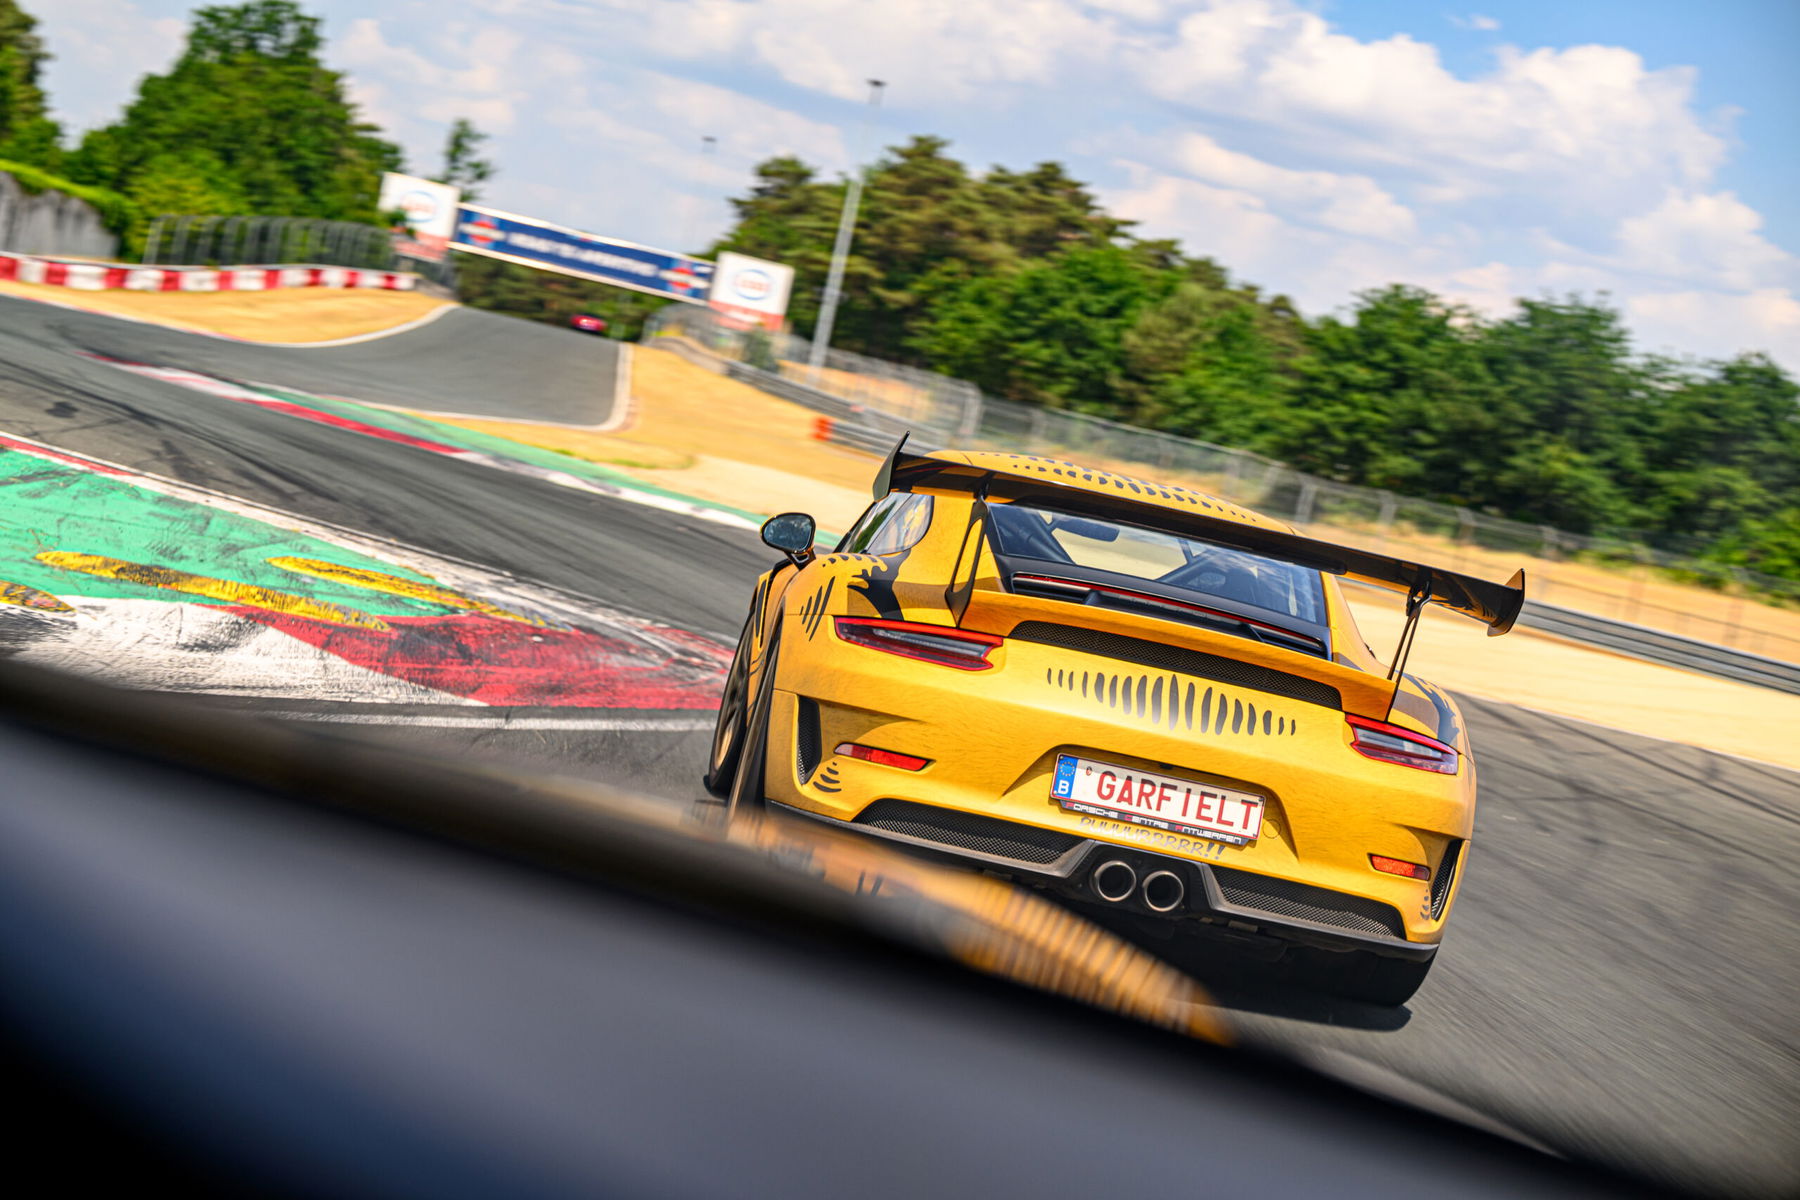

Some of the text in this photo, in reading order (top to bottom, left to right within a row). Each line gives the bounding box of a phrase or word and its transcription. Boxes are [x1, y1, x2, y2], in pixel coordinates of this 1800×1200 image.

[1058, 780, 1070, 794] B
[1096, 771, 1258, 830] GARFIELT
[1065, 802, 1242, 845] PORSCHE CENTRE ANTWERPEN
